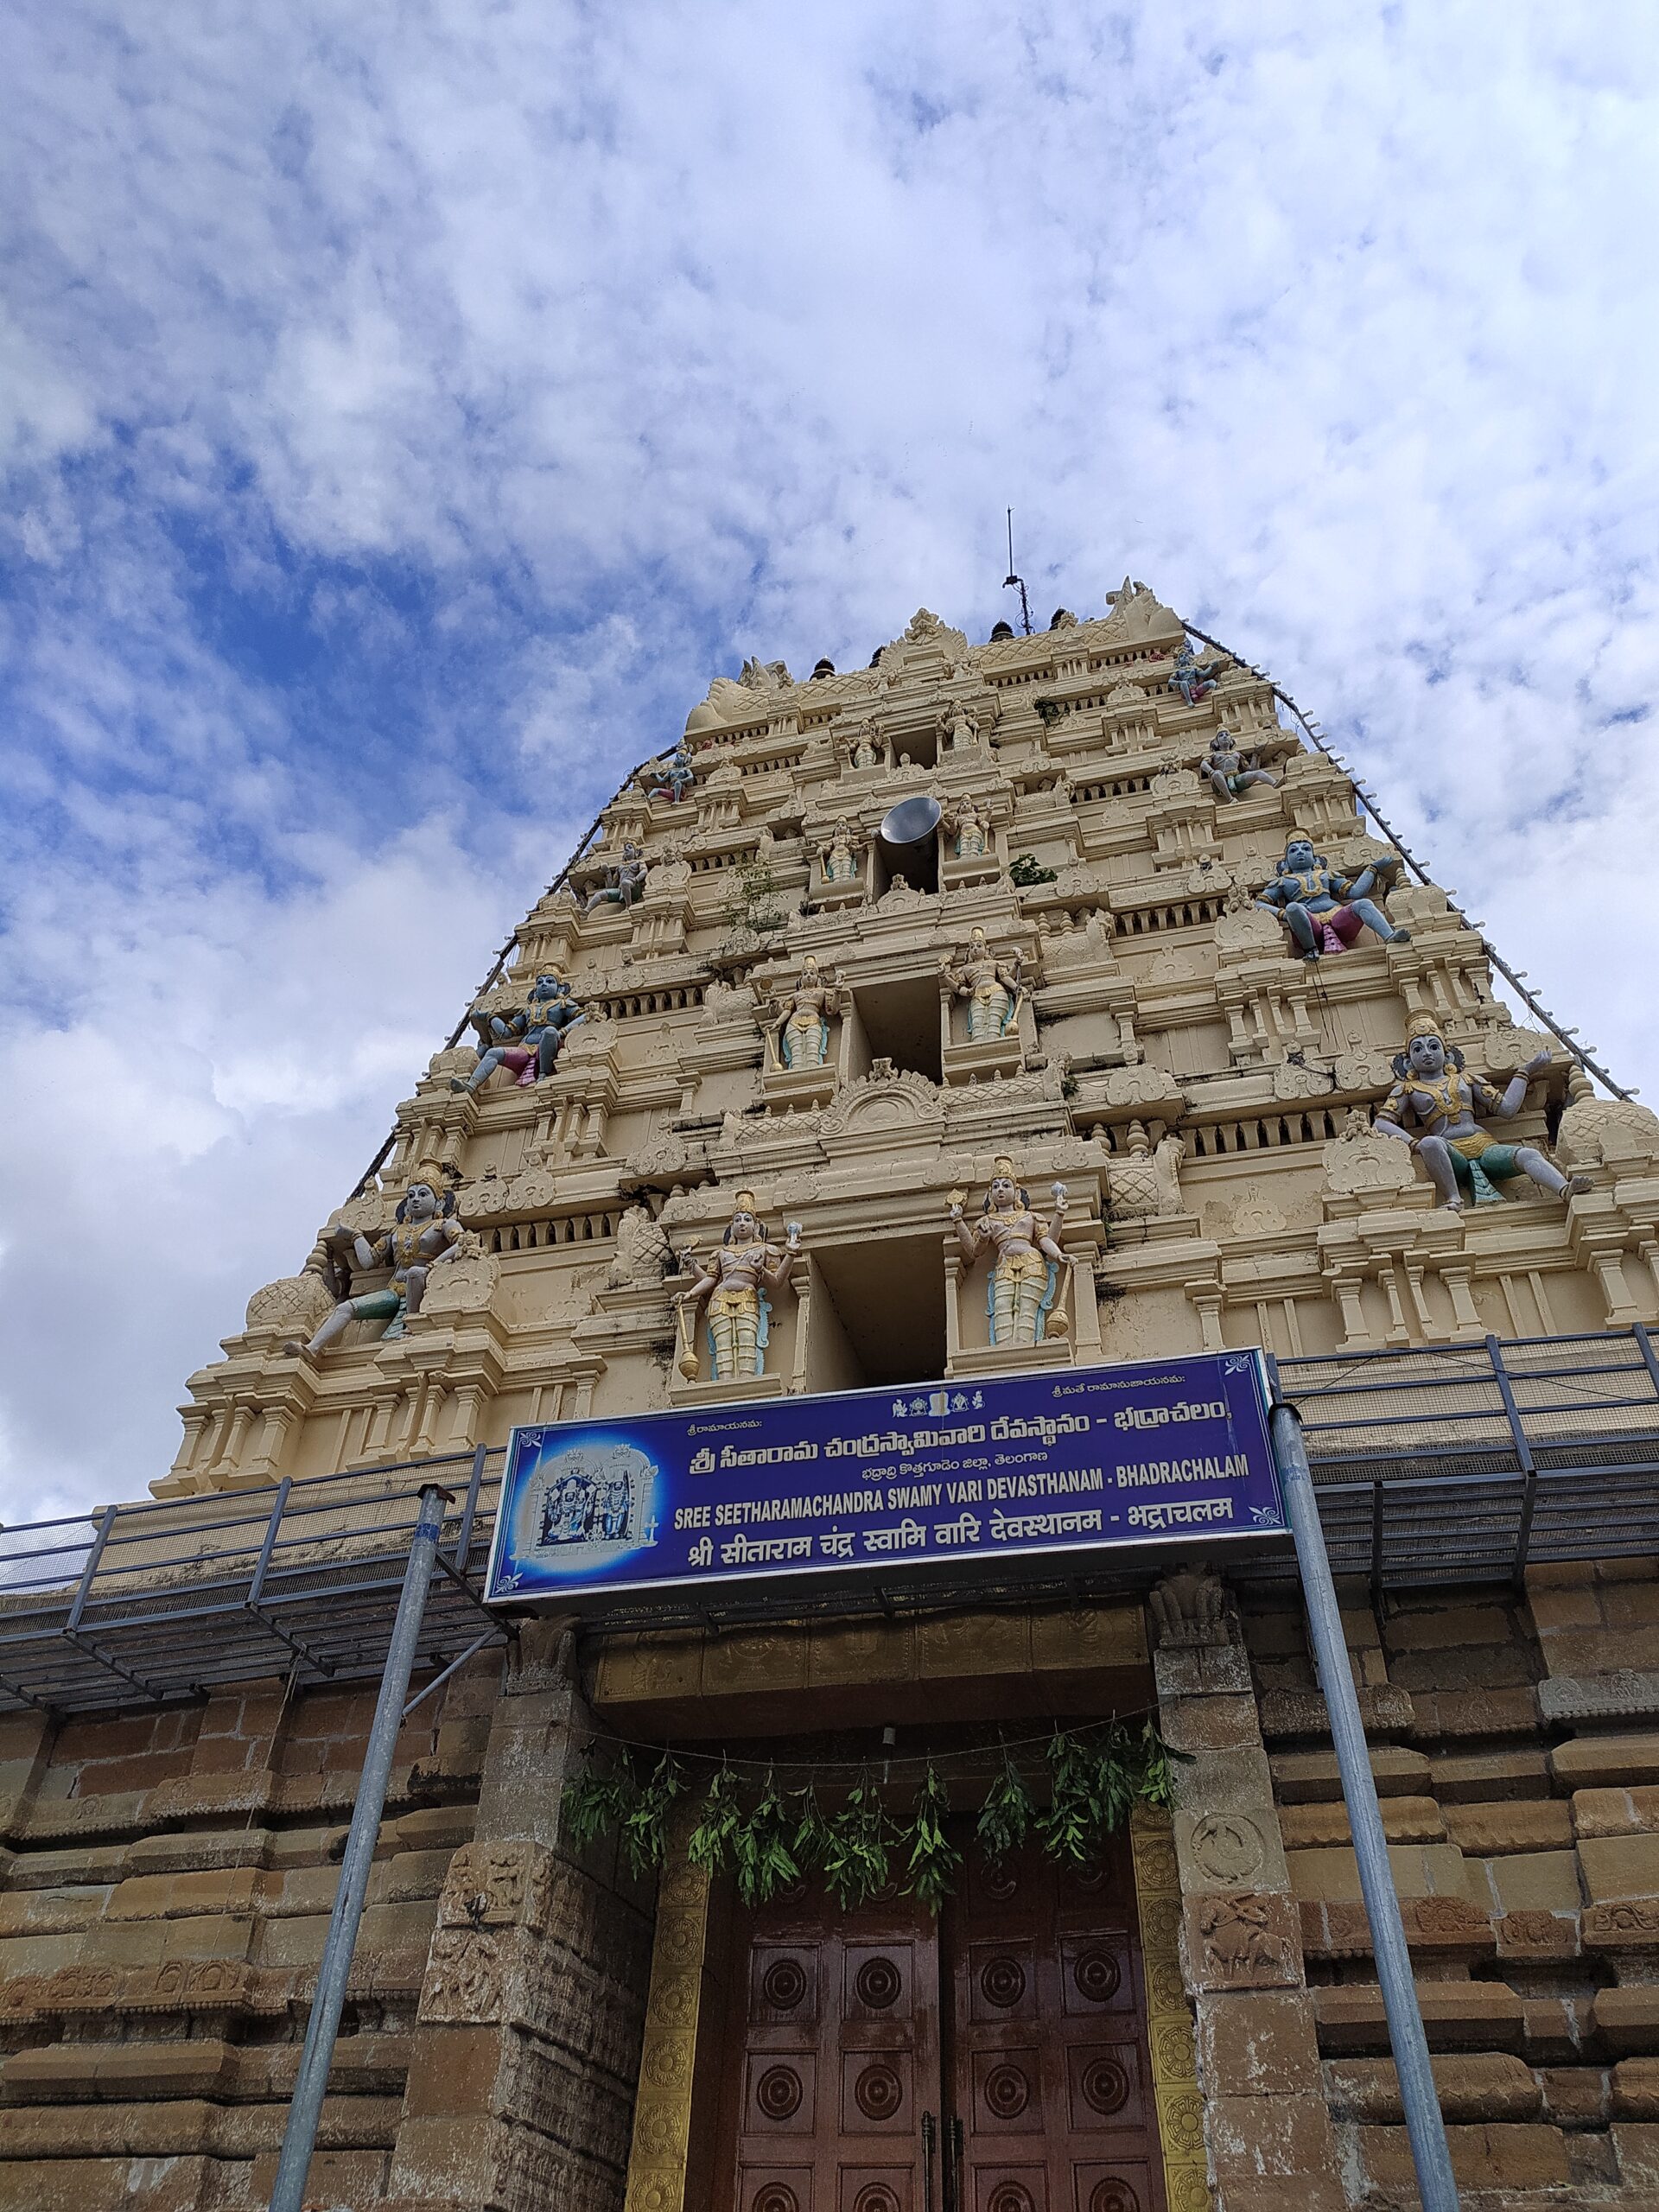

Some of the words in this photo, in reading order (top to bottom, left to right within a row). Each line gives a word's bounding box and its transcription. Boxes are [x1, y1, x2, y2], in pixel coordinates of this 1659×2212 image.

[689, 1447, 715, 1474] శ్రీ
[720, 1440, 818, 1468] సీతారామ
[823, 1424, 986, 1458] చంద్రస్వామివారి
[990, 1414, 1090, 1446] దేవస్థానం
[861, 1467, 898, 1481] భద్రాద్రి
[899, 1459, 960, 1478] కొత్తగూడెం
[995, 1452, 1048, 1466] తెలంగాణ
[674, 1504, 711, 1530] SREE
[715, 1488, 884, 1527] SEETHARAMACHANDRA
[887, 1483, 944, 1511] SWAMY
[946, 1478, 983, 1504] VARI
[988, 1467, 1104, 1501] DEVASTHANAM
[1116, 1453, 1249, 1488] BHADRACHALAM
[687, 1536, 715, 1567] श्री
[721, 1533, 812, 1566] सीताराम
[820, 1525, 855, 1559] चंद्र
[862, 1518, 927, 1553] स्वामि
[934, 1511, 981, 1546] वारि
[988, 1507, 1103, 1542] देवस्थानम
[1128, 1497, 1234, 1530] भद्राचलम
